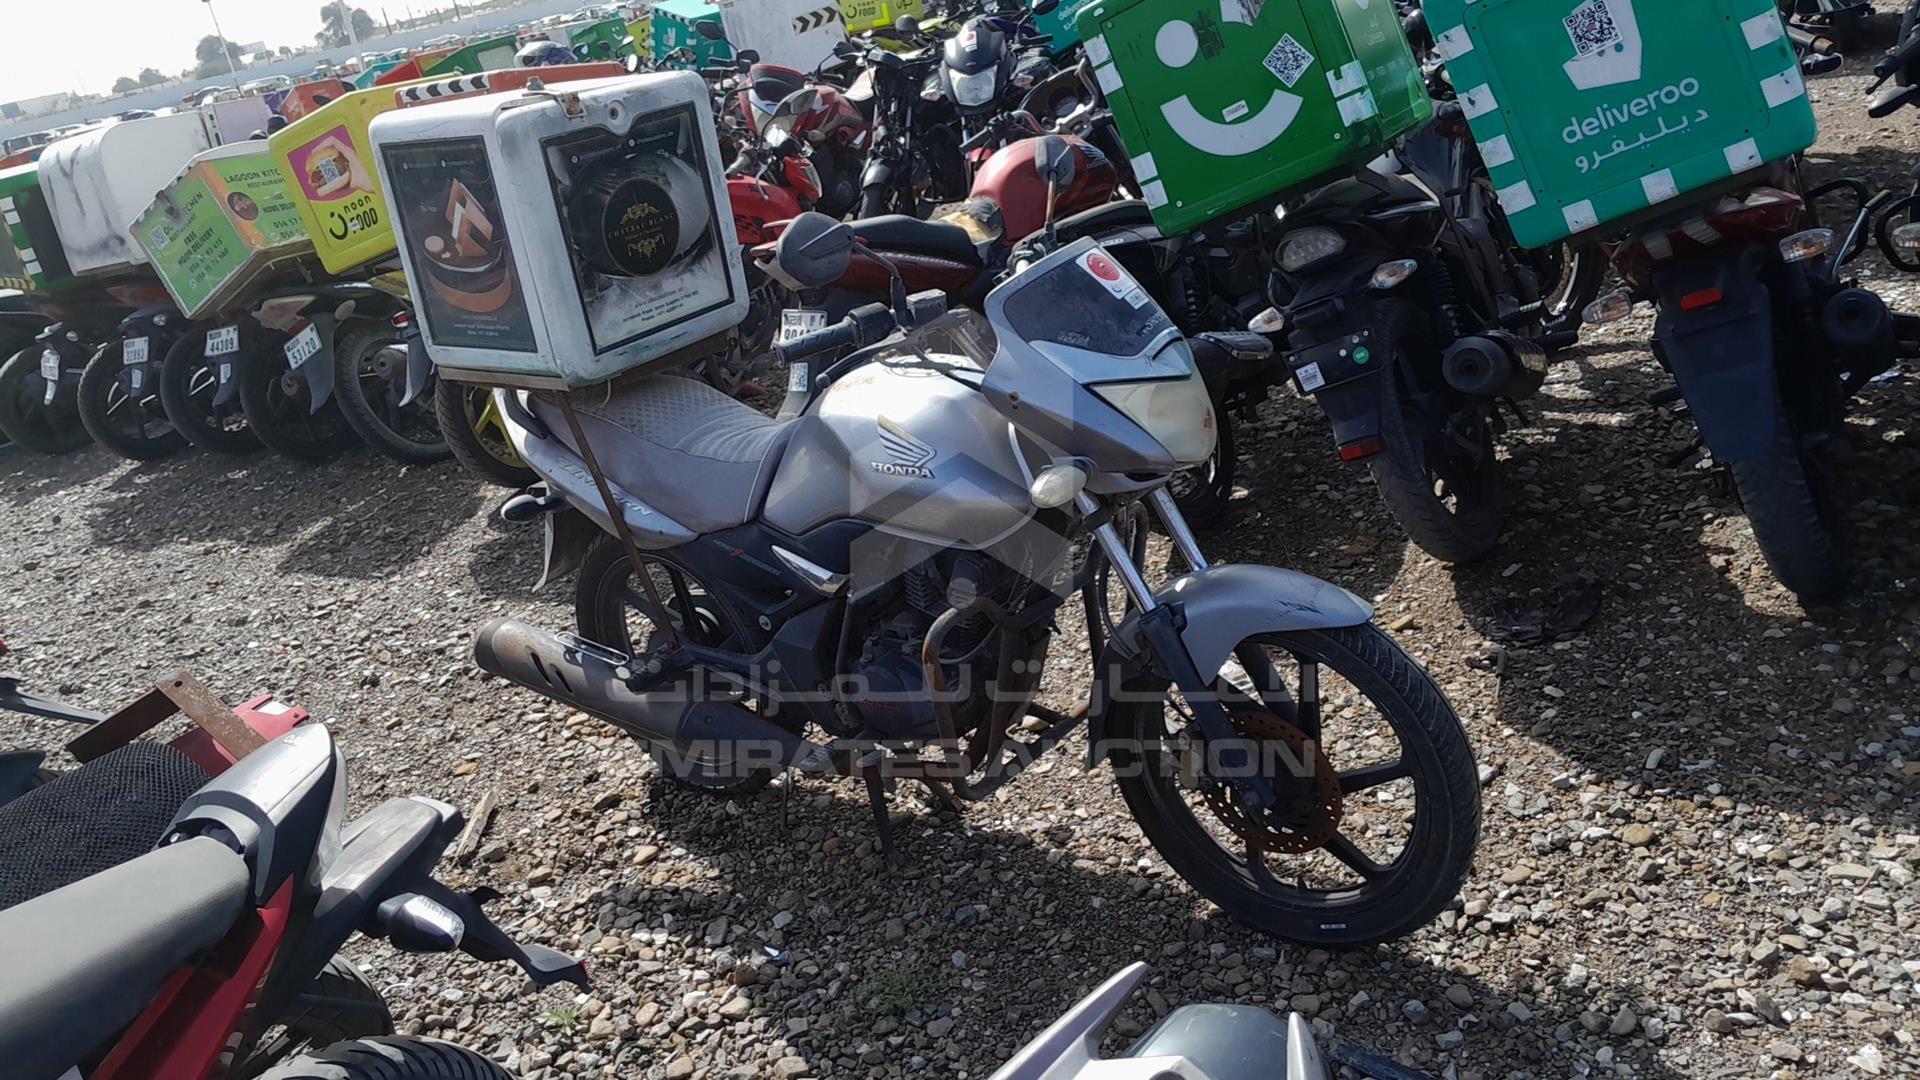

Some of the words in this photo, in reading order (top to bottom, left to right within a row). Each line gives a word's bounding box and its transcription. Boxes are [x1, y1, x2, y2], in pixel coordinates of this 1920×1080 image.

[1562, 77, 1699, 144] deliveroo
[1575, 108, 1709, 174] ديليفرو
[224, 171, 261, 184] LAGOON
[261, 168, 281, 178] KITC
[343, 195, 372, 214] noon
[291, 337, 316, 365] 53120
[871, 461, 936, 479] HONDA
